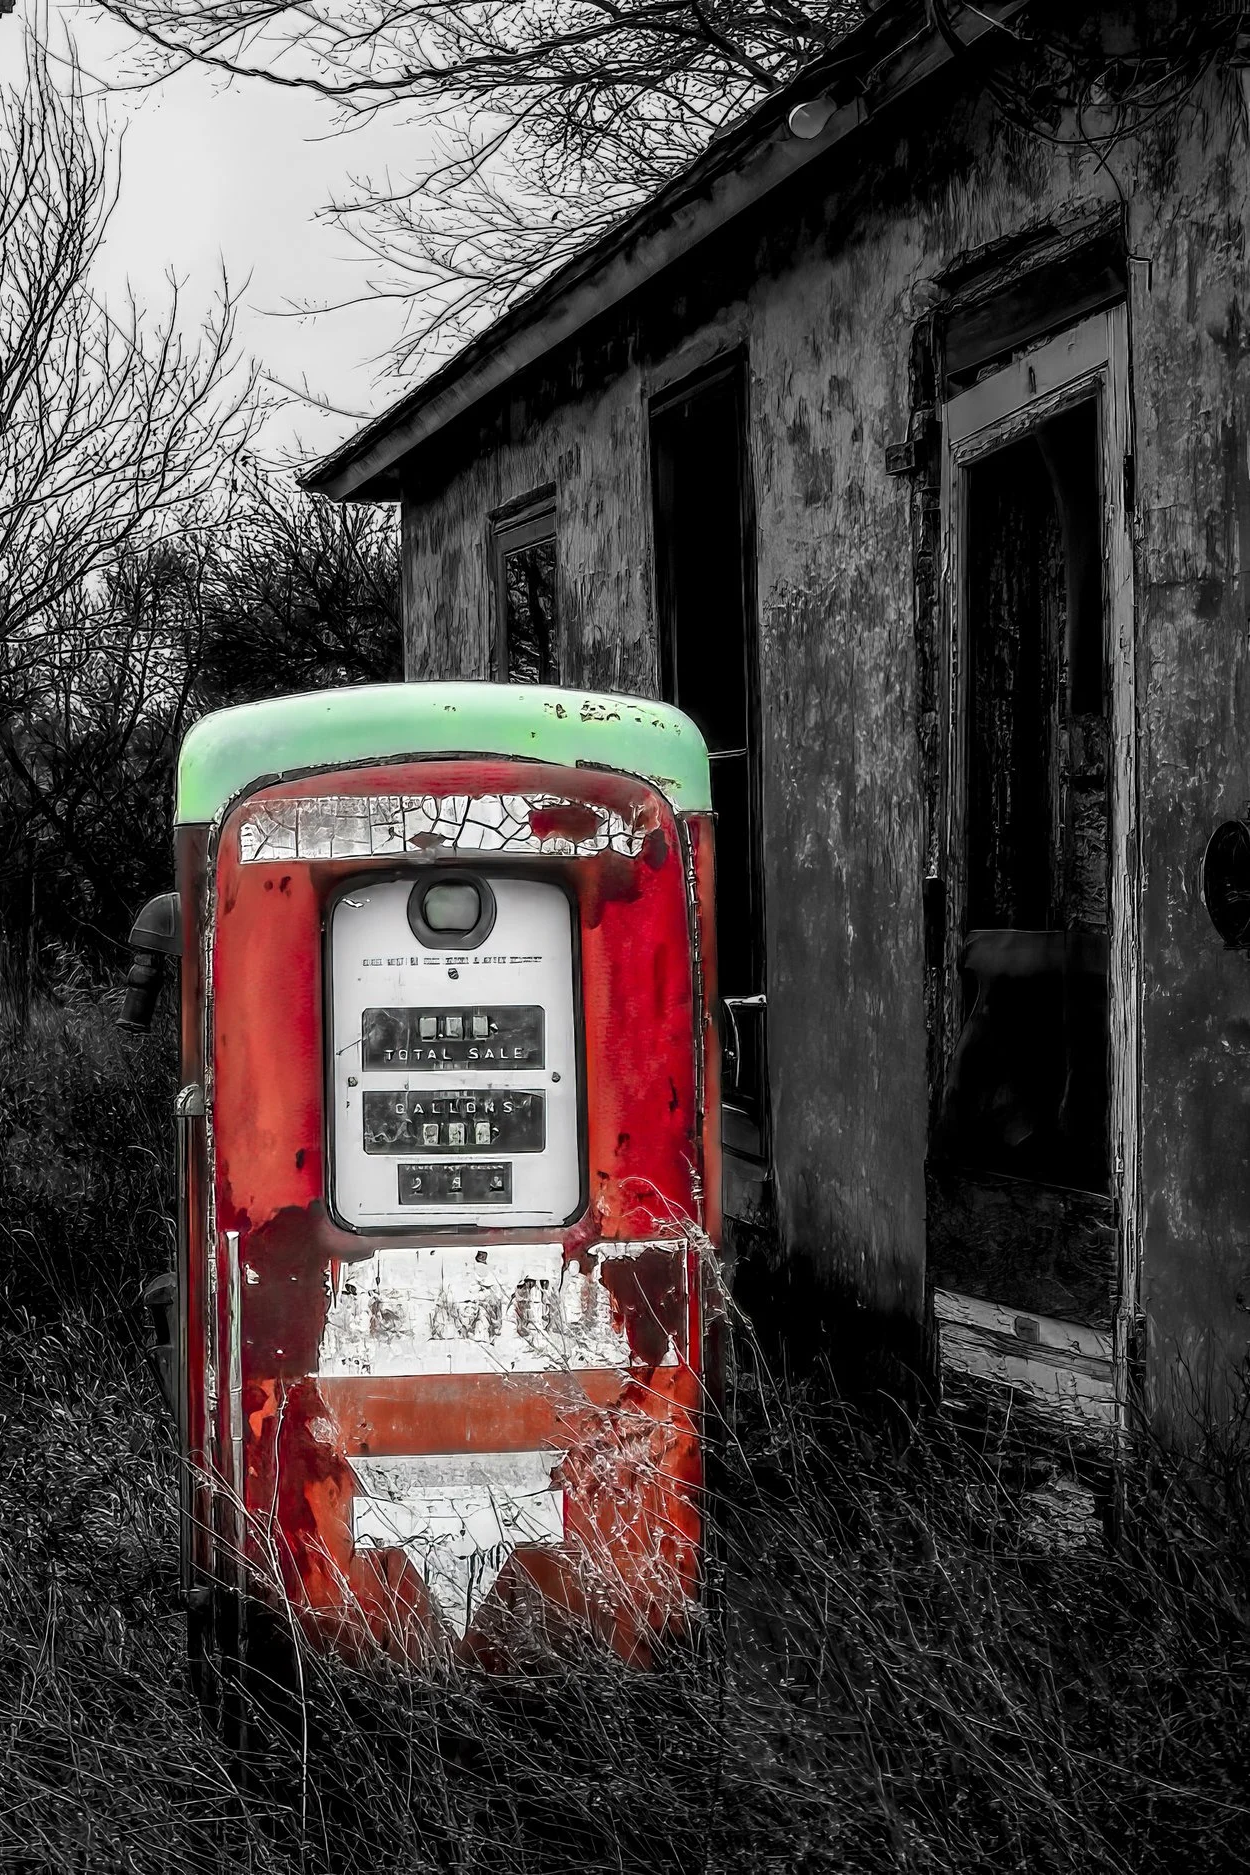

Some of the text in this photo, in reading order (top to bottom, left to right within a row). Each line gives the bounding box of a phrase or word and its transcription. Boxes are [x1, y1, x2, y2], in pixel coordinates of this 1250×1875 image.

[384, 1047, 525, 1060] TOTAL SALE
[395, 1101, 514, 1114] GALLONS
